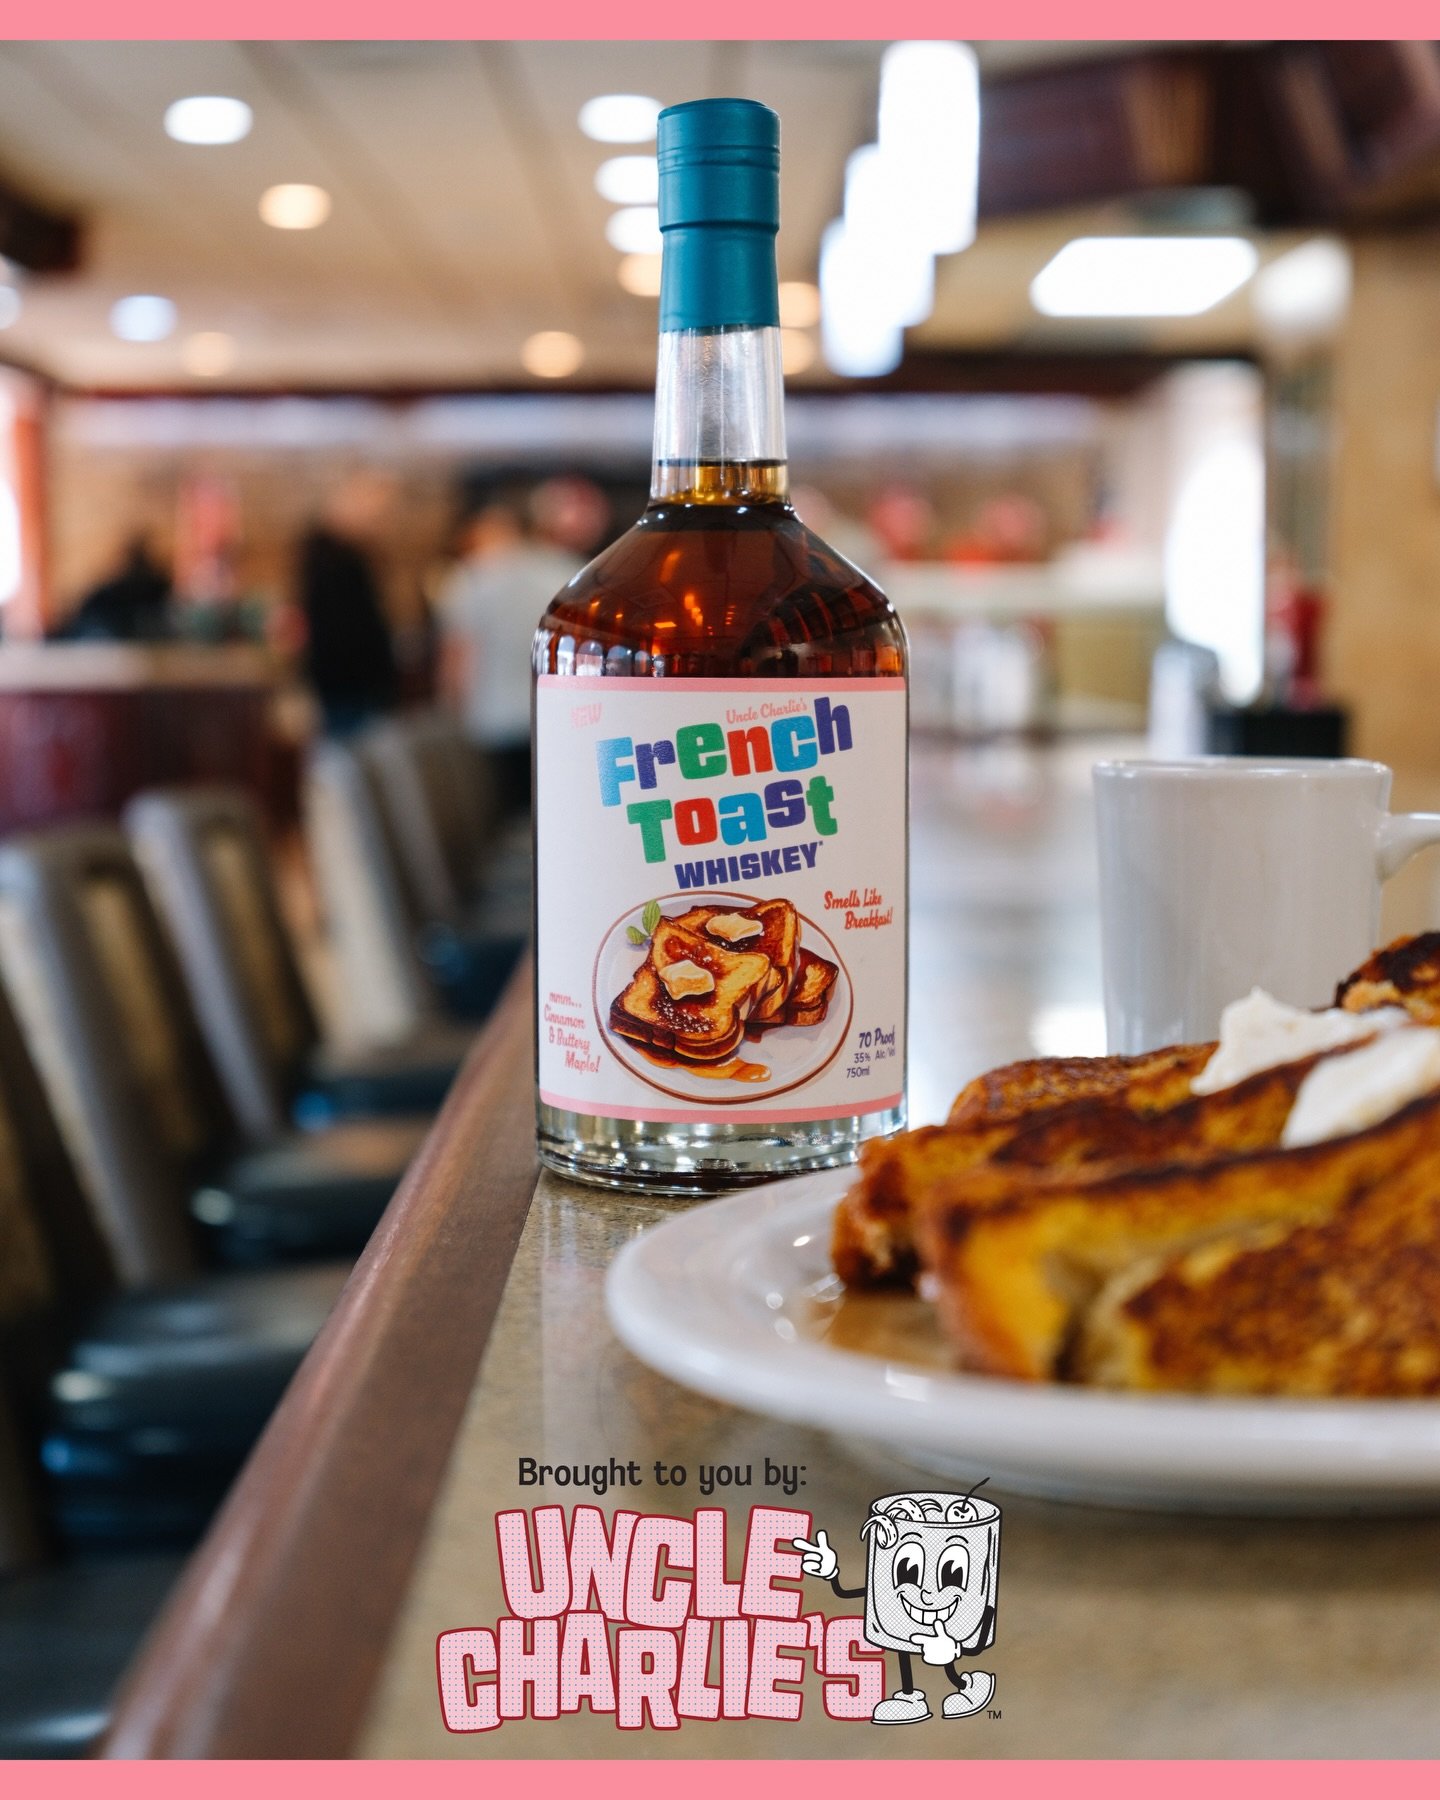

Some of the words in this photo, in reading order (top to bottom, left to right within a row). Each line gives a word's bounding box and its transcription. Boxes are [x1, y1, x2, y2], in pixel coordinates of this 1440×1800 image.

[726, 706, 757, 724] Uncle
[760, 698, 807, 718] Charlie's
[596, 696, 853, 807] French
[626, 775, 838, 864] Toast
[674, 841, 818, 890] WHISKEY
[824, 889, 860, 910] Smells
[863, 888, 882, 907] Like
[845, 906, 893, 930] Breakfast!
[544, 1003, 586, 1029] Cinnamon
[549, 1026, 555, 1043] &
[557, 1028, 590, 1055] Buttery
[859, 1032, 872, 1048] 70
[874, 1025, 896, 1046] Proof
[565, 1050, 601, 1075] Maple!
[854, 1052, 871, 1064] 35%
[847, 1065, 870, 1079] 750ml
